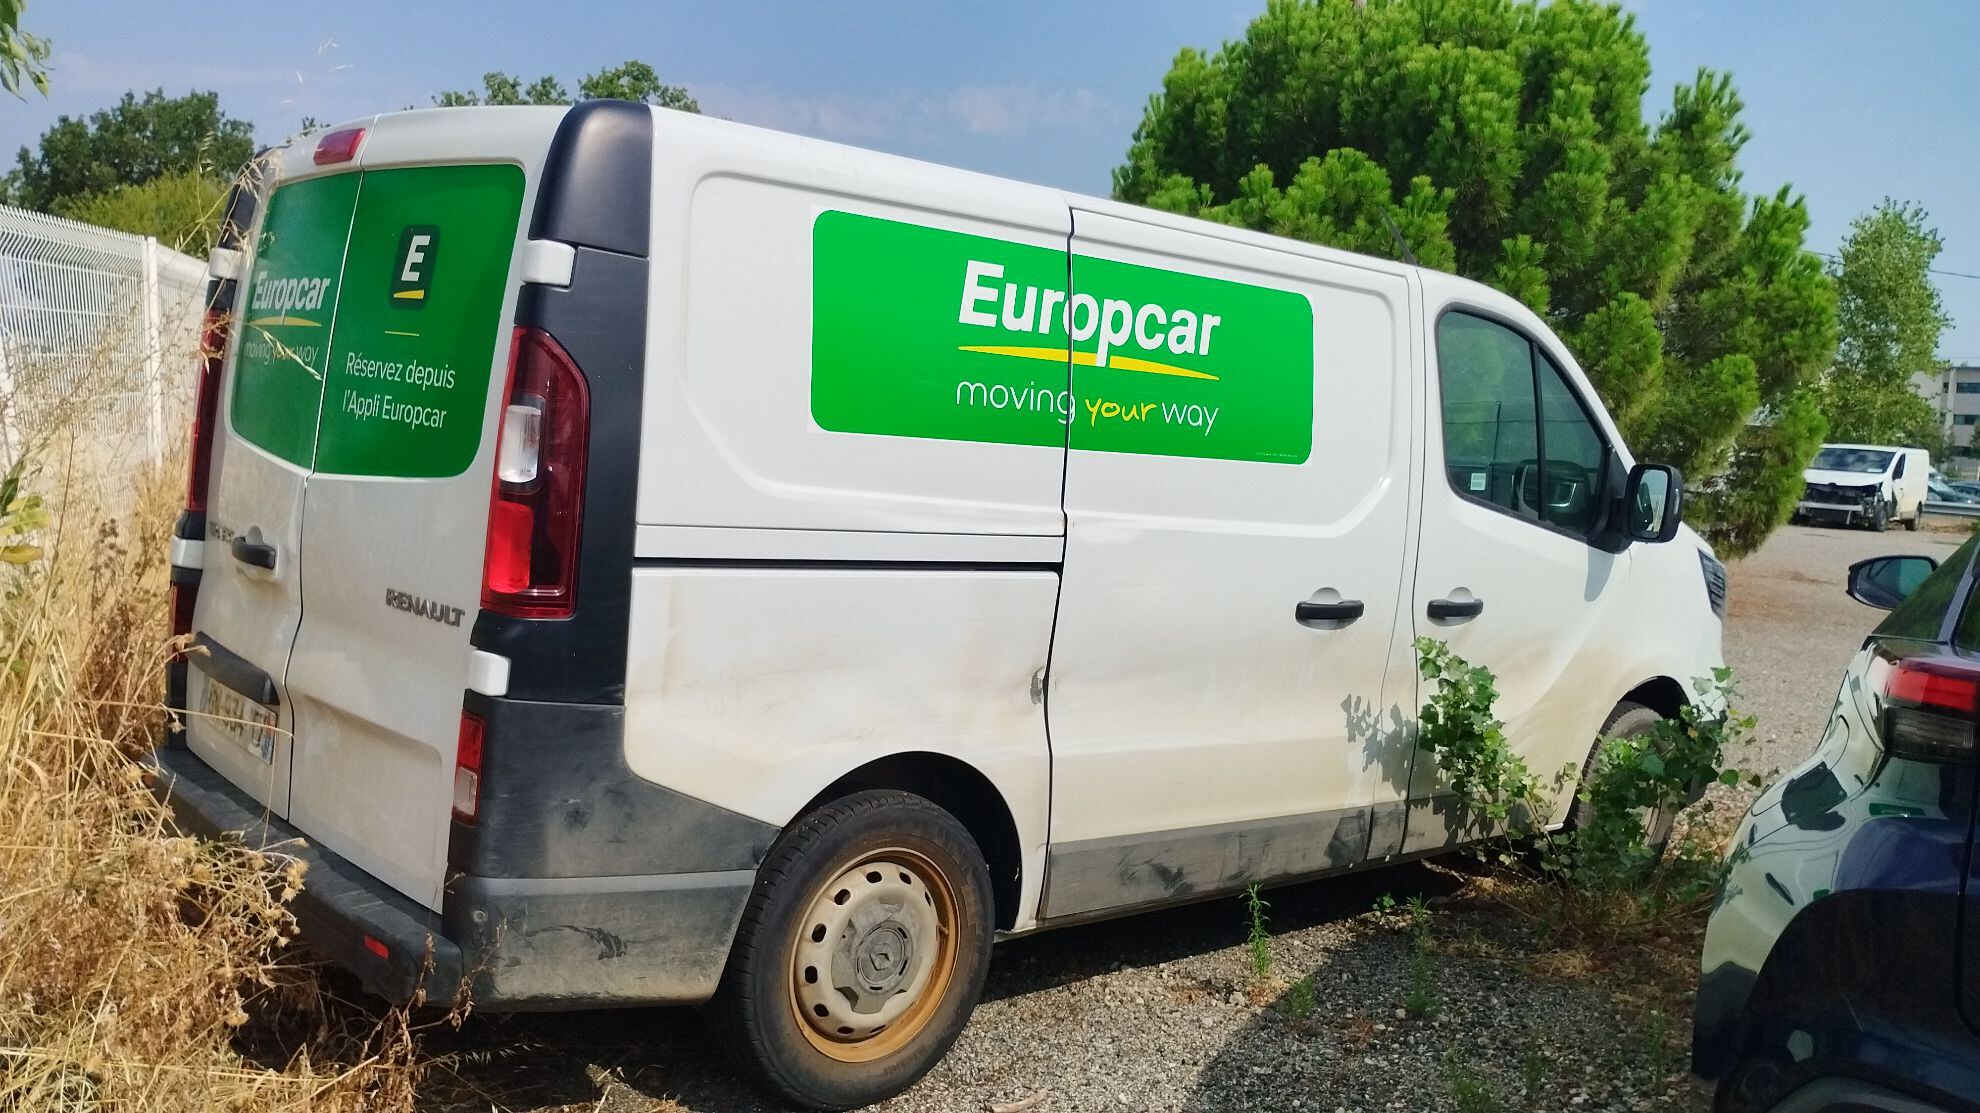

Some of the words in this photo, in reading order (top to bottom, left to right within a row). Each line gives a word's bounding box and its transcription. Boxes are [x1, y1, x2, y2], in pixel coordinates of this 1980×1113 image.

[401, 235, 431, 282] E
[251, 271, 331, 325] Europcar
[958, 260, 1221, 367] Europcar
[244, 342, 271, 365] moving
[345, 351, 403, 382] Réservez
[405, 359, 456, 391] depuis
[342, 389, 381, 421] l'Appli
[382, 395, 448, 430] Europcar
[956, 381, 1076, 425] moving
[1084, 398, 1158, 427] your
[1161, 402, 1220, 436] way
[385, 588, 465, 627] RENAULT
